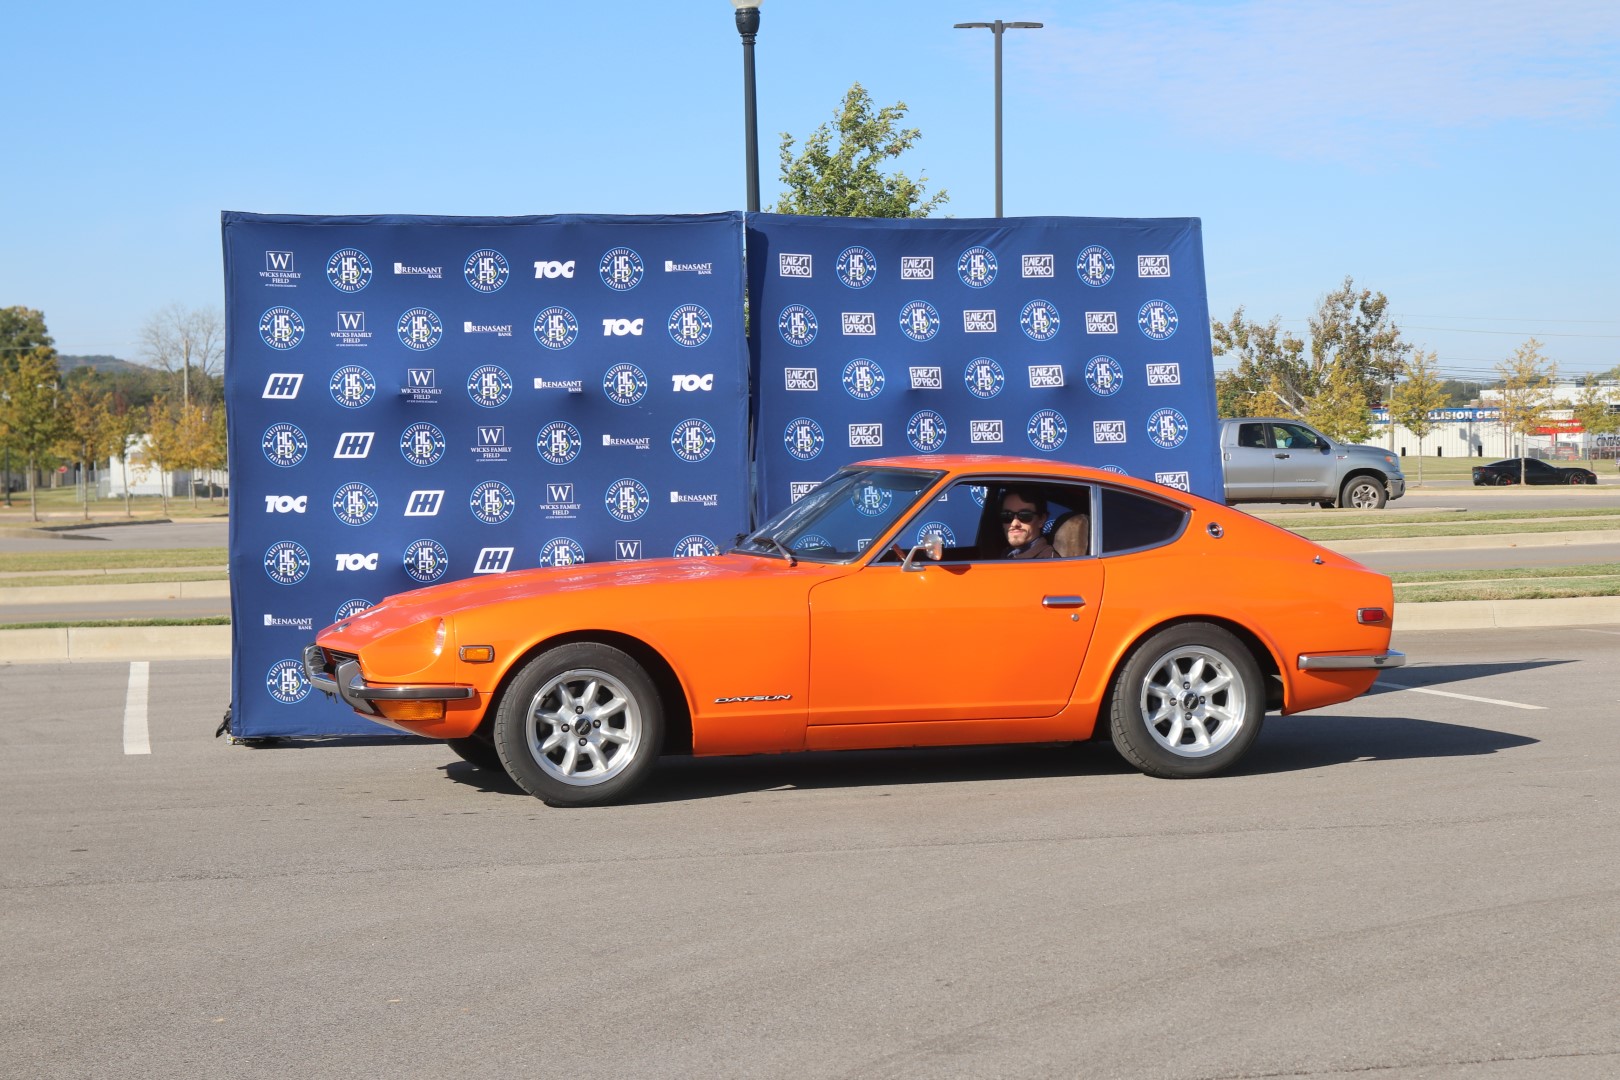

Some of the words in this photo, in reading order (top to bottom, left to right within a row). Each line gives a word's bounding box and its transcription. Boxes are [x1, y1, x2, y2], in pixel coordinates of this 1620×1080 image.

[268, 254, 290, 270] W
[342, 257, 356, 270] HC
[479, 258, 494, 271] HC
[614, 256, 628, 269] HC
[786, 256, 809, 265] NEXT
[849, 255, 863, 268] HC
[907, 260, 930, 268] NEXT
[971, 254, 984, 267] HC
[1028, 257, 1051, 266] NEXT
[1089, 253, 1102, 266] HC
[1144, 257, 1167, 266] NEXT
[534, 261, 575, 278] TOC
[676, 263, 712, 273] RENASANT
[682, 313, 697, 326] HC
[849, 314, 873, 323] NEXT
[912, 308, 926, 321] HC
[970, 312, 994, 321] NEXT
[1033, 307, 1046, 320] HC
[1092, 314, 1115, 323] NEXT
[274, 315, 289, 328] HC
[340, 314, 362, 329] W
[412, 316, 426, 329] HC
[548, 315, 563, 328] HC
[602, 318, 644, 336] TOC
[792, 370, 815, 379] NEXT
[856, 366, 870, 379] HC
[916, 369, 939, 378] NEXT
[978, 365, 990, 378] HC
[1035, 368, 1061, 376] NEXT
[1097, 363, 1110, 376] HC
[1153, 366, 1178, 374] NEXT
[345, 374, 360, 387] HC
[410, 372, 432, 386] W
[482, 374, 496, 386] HC
[617, 372, 632, 386] HC
[672, 374, 713, 392] TOC
[920, 418, 932, 431] HC
[977, 422, 1000, 431] NEXT
[1040, 417, 1053, 430] HC
[1100, 422, 1123, 431] NEXT
[1160, 416, 1174, 428] HC
[480, 429, 502, 444] W
[551, 430, 566, 443] HC
[685, 427, 700, 440] HC
[797, 426, 810, 439] HC
[856, 426, 879, 434] NEXT
[277, 431, 292, 444] HC
[415, 431, 430, 444] HC
[348, 491, 362, 504] HC
[485, 489, 500, 502] HC
[549, 486, 570, 502] W
[619, 487, 634, 500] HC
[265, 495, 307, 513] TOC
[418, 548, 432, 561] HC
[554, 546, 569, 558] HC
[618, 542, 638, 557] W
[279, 550, 294, 563] HC
[335, 553, 378, 571] TOC
[282, 668, 296, 682] HC
[714, 694, 792, 704] DATSUN
